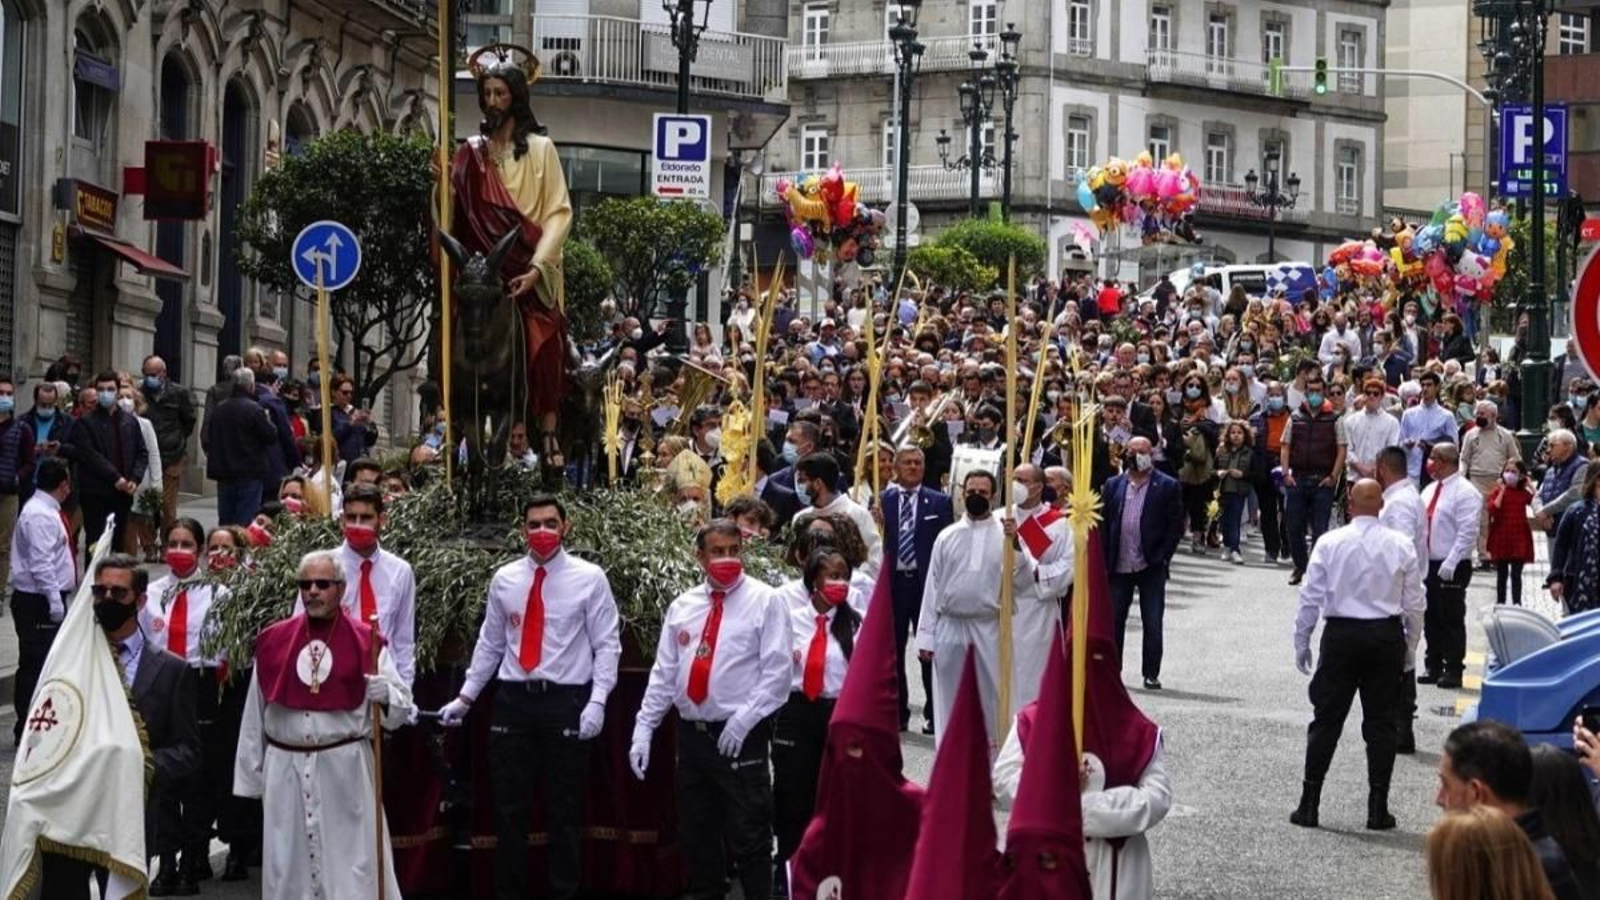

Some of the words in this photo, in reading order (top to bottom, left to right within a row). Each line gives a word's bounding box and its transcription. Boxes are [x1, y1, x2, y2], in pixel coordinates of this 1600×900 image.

[665, 121, 701, 157] P
[1513, 115, 1554, 163] P
[661, 162, 701, 171] Eldorado
[657, 174, 704, 184] ENTRADA
